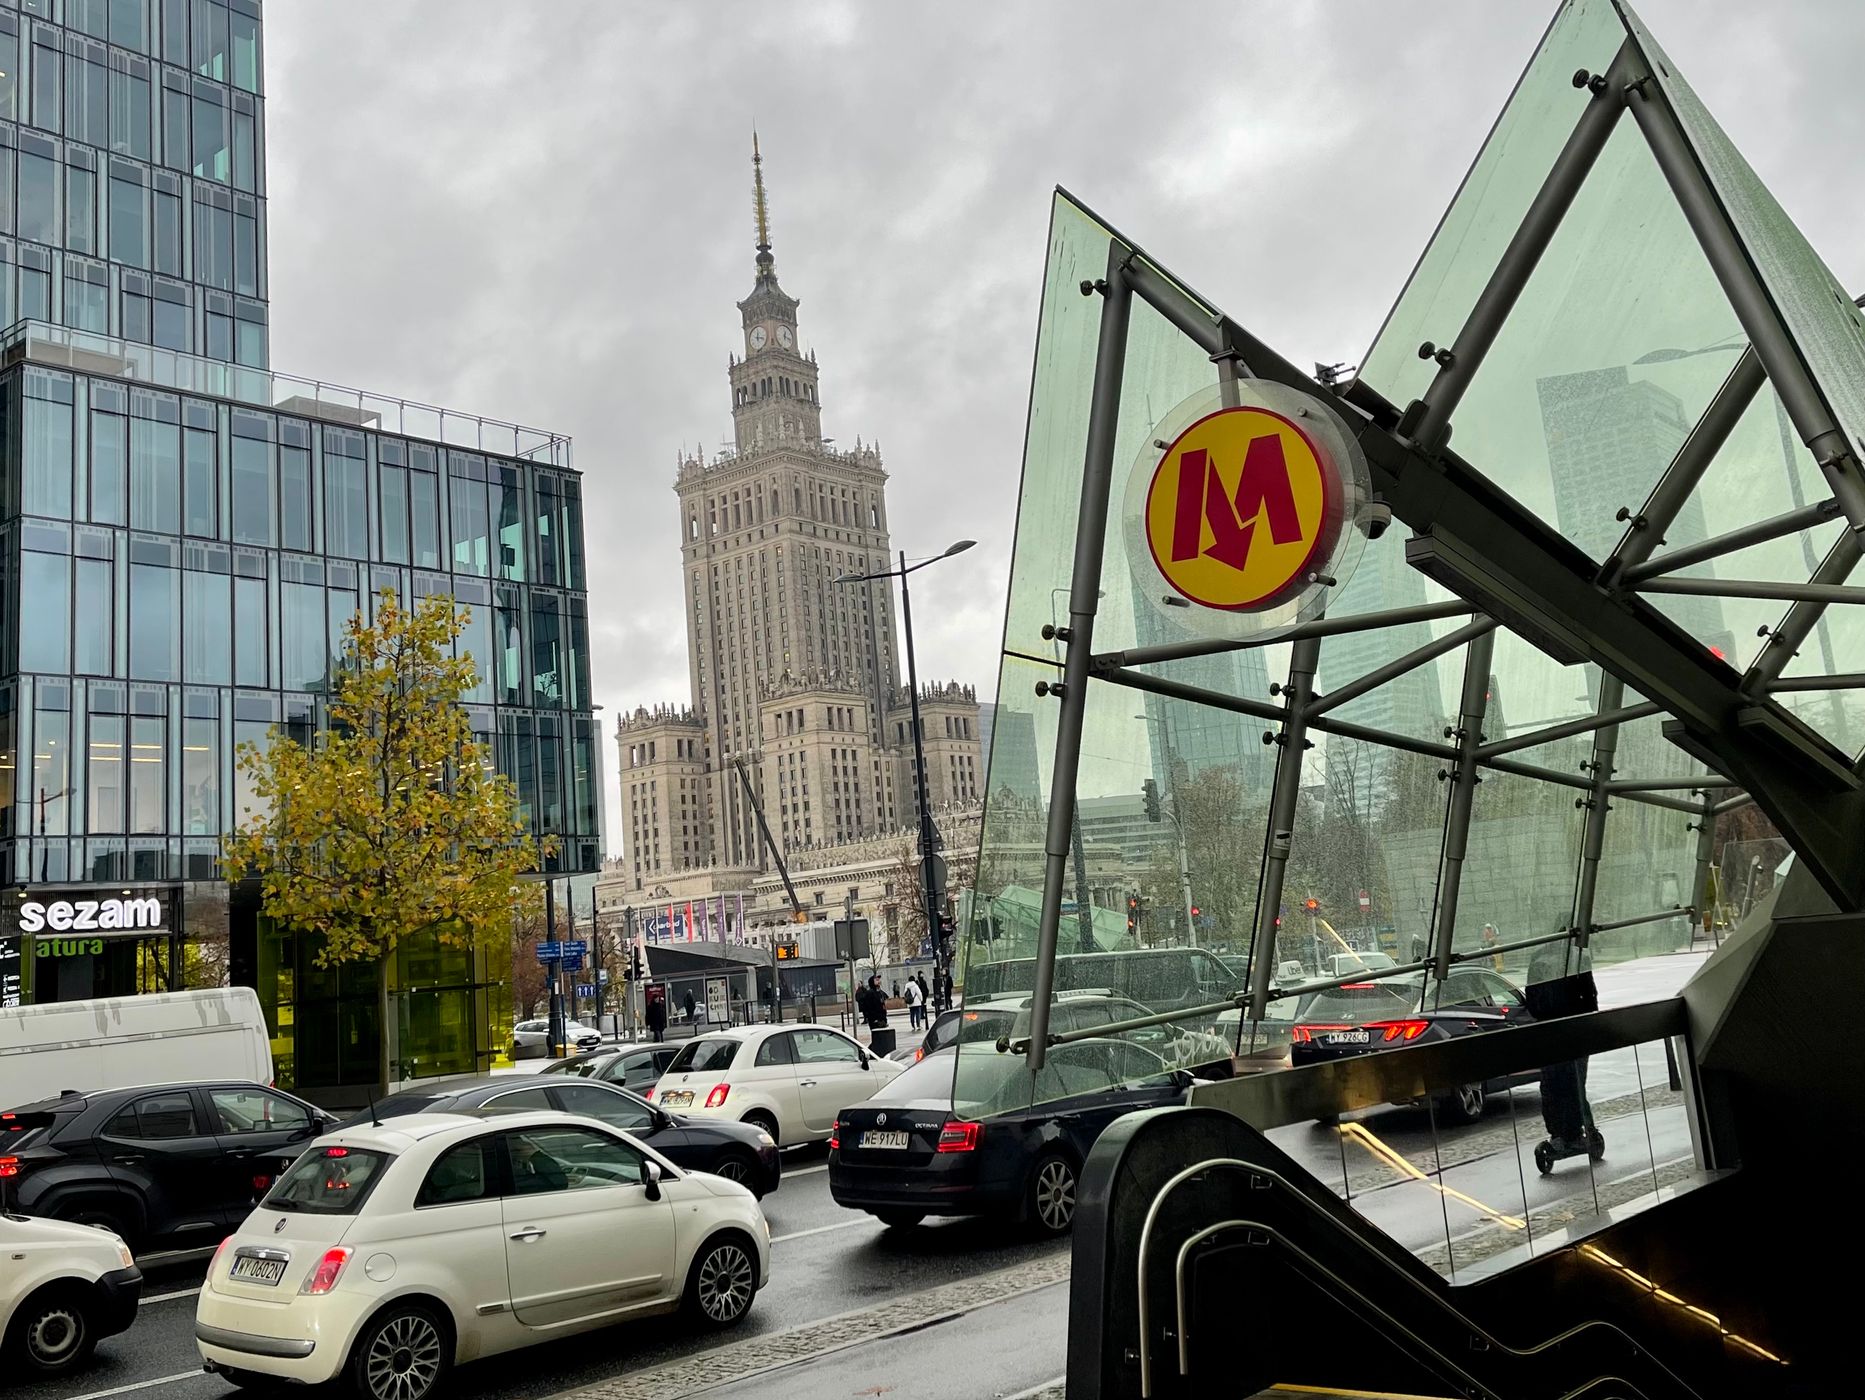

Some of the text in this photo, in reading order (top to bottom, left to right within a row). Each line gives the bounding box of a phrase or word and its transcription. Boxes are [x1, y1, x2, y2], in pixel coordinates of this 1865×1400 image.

[1171, 433, 1302, 571] M
[19, 898, 161, 932] sezam
[36, 938, 104, 958] atura
[864, 1132, 908, 1146] WE 917LU
[237, 1258, 282, 1280] WY 0602N
